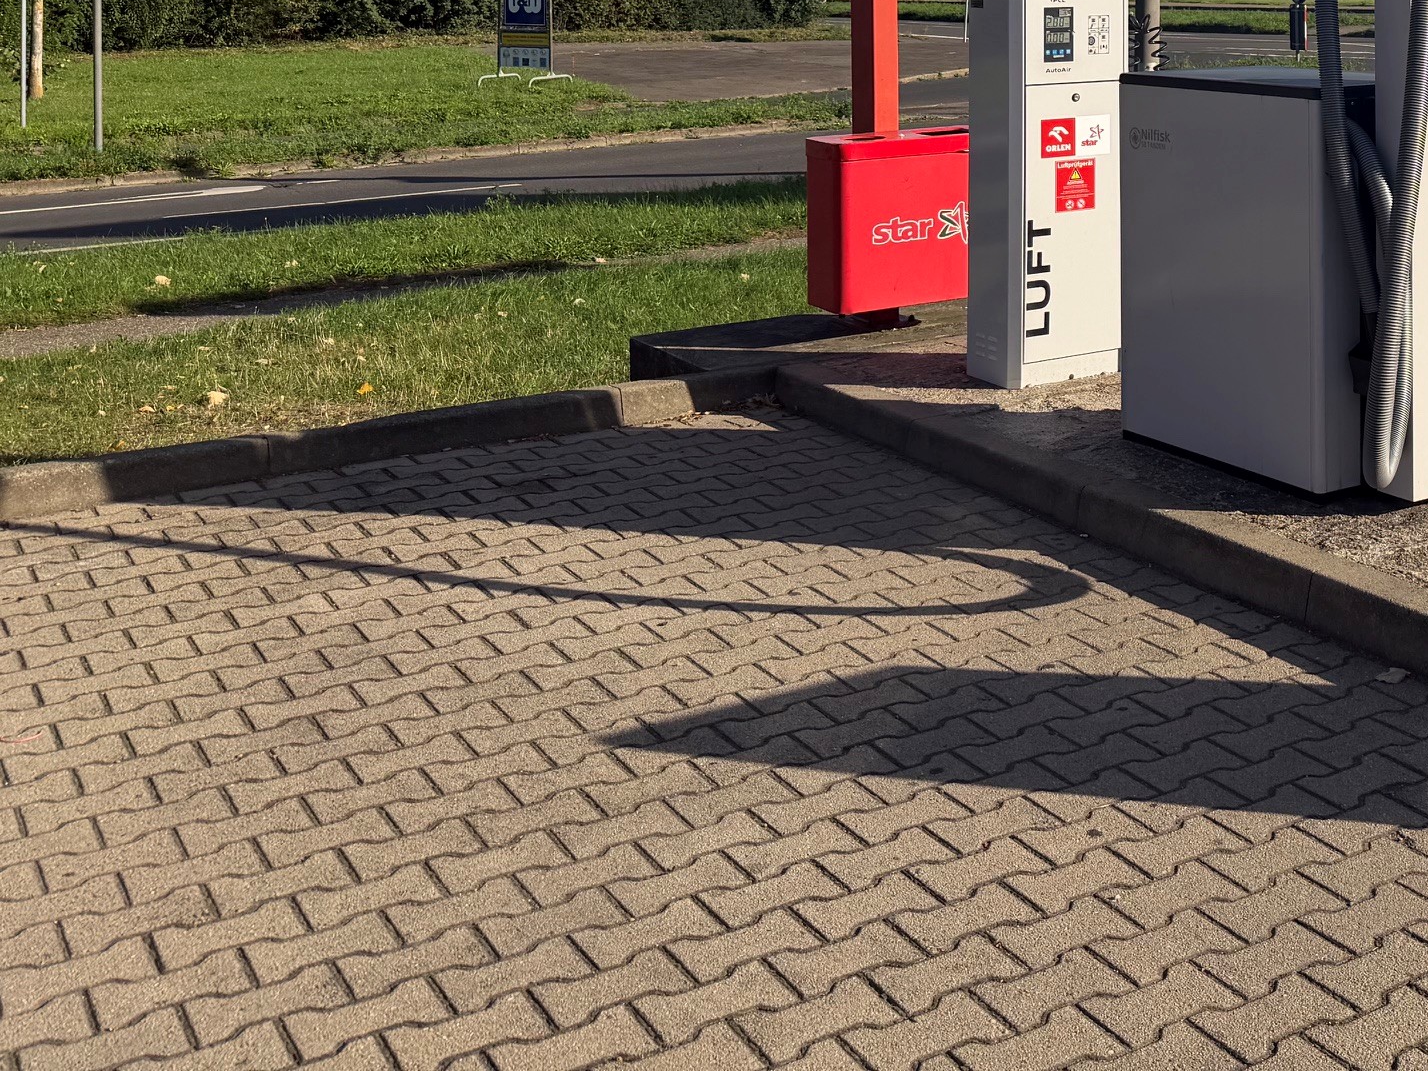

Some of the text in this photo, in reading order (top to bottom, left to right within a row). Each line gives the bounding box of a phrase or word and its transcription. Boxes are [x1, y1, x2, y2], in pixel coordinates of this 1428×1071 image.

[1045, 66, 1072, 74] AutoAir
[1141, 128, 1171, 143] Nilfisk
[1045, 143, 1072, 152] ORLEN
[1080, 139, 1098, 147] star
[872, 216, 934, 245] star
[1025, 219, 1052, 338] LUFT
